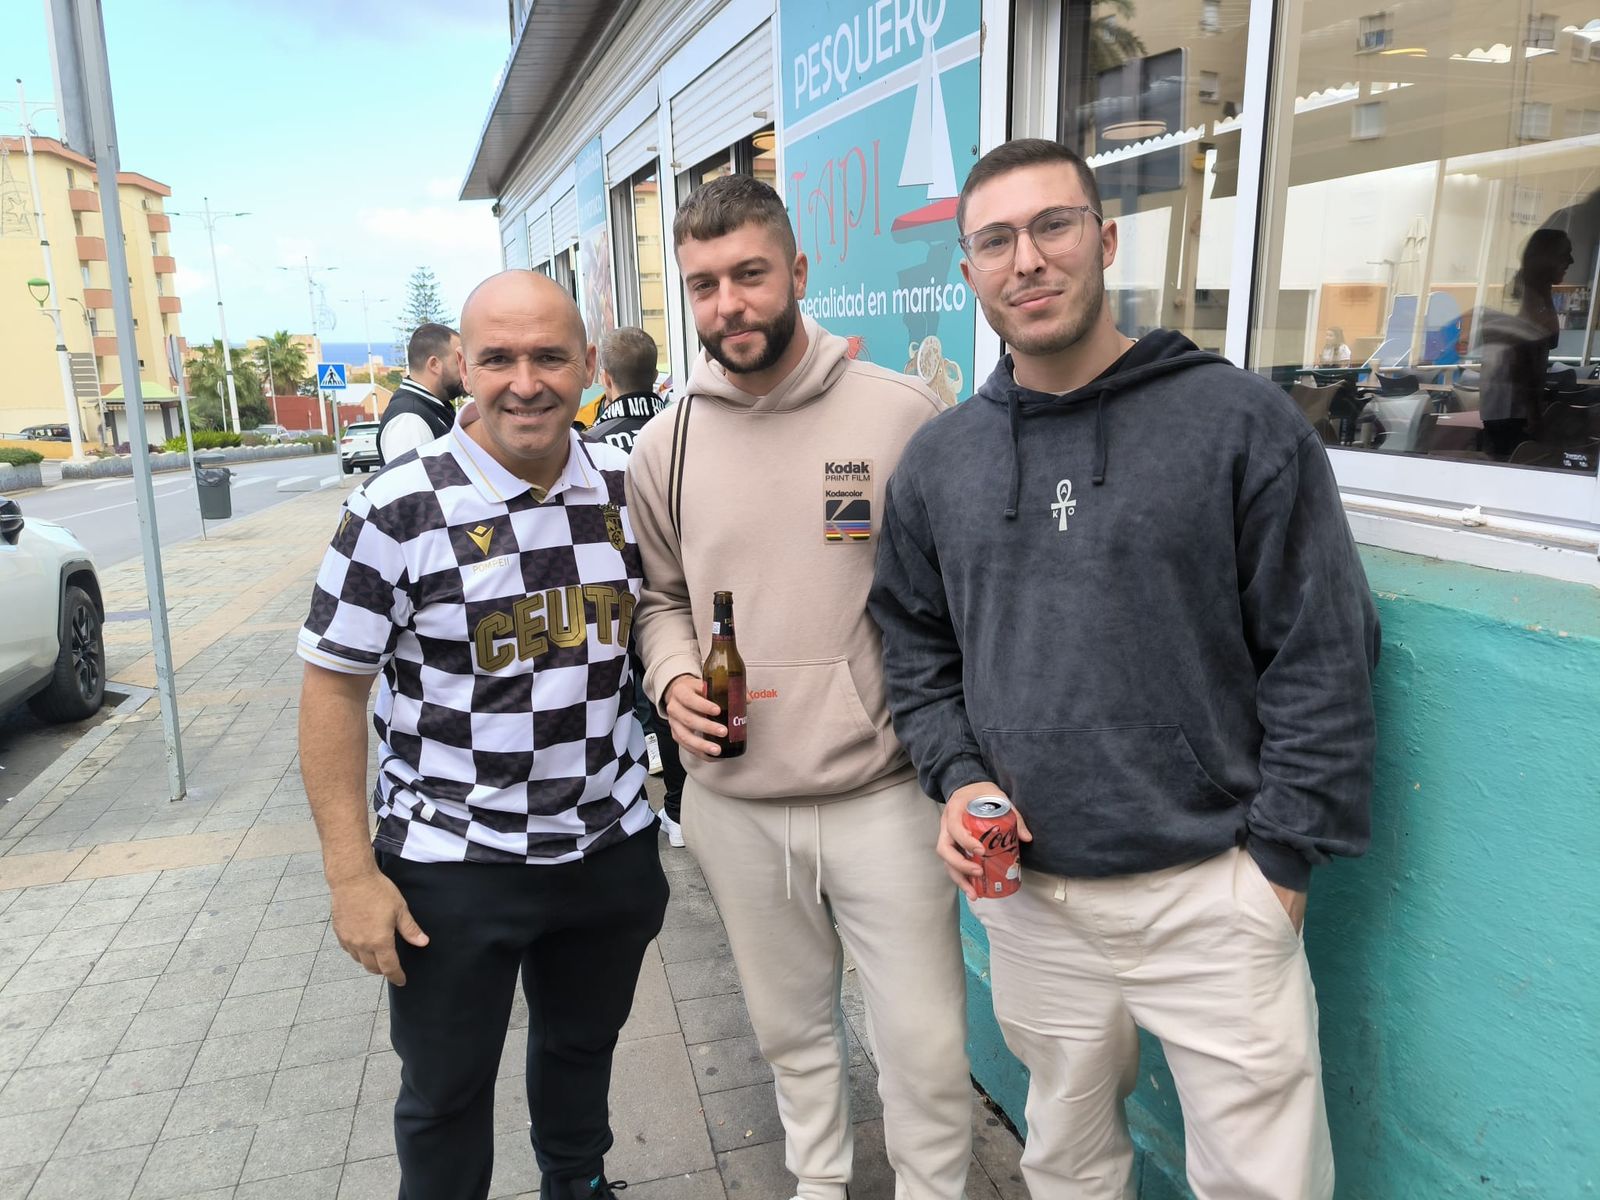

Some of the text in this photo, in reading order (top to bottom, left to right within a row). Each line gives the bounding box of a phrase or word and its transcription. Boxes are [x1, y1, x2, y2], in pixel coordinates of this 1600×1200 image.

[799, 276, 966, 319] pecialidad en marisco
[825, 461, 870, 474] Kodak
